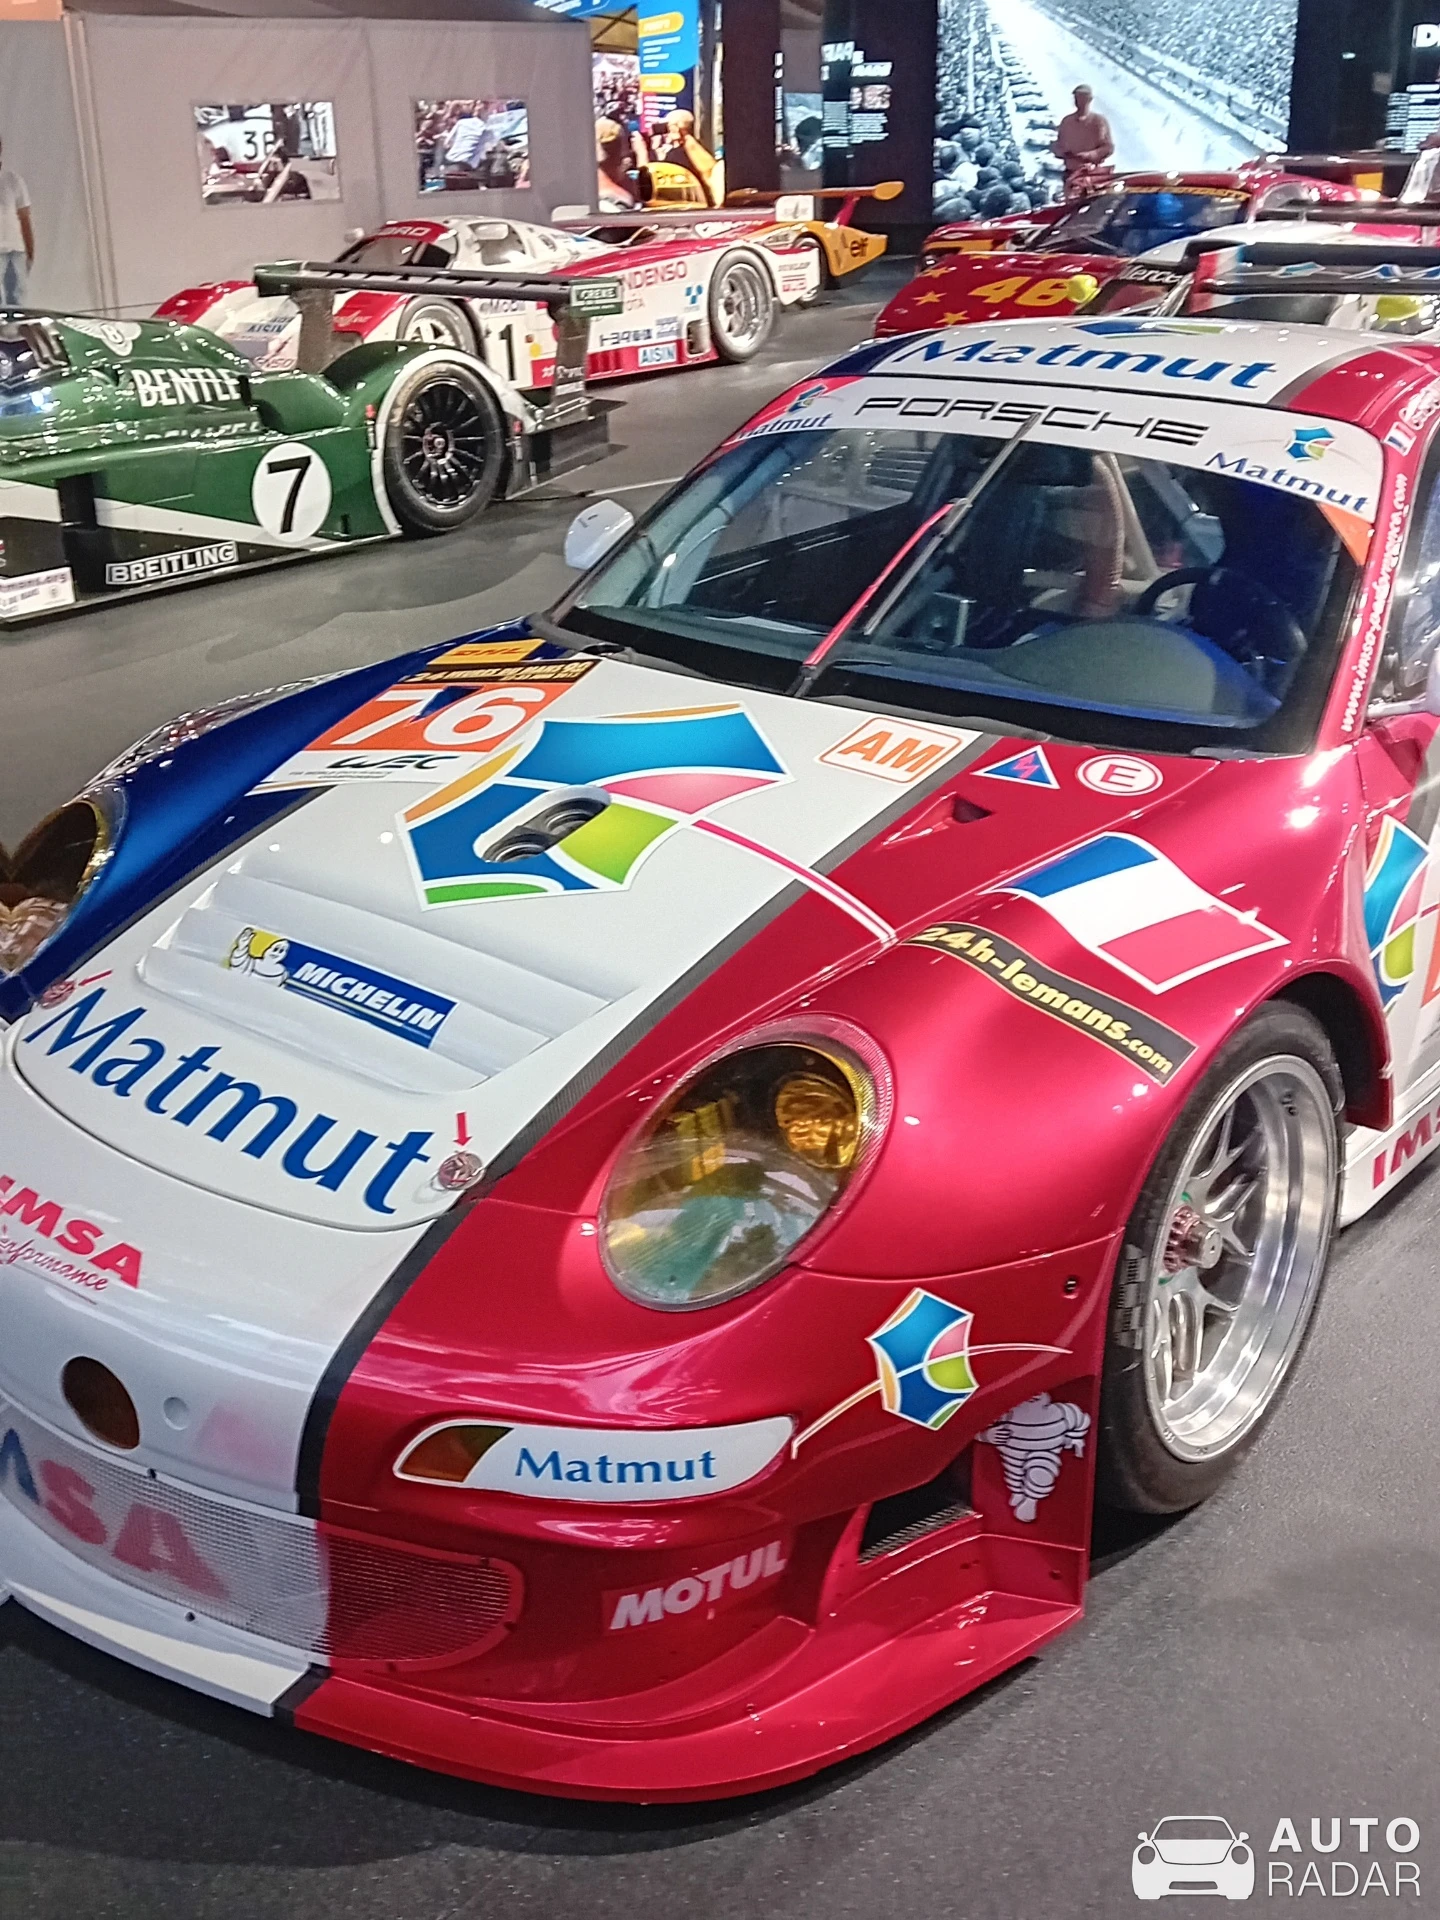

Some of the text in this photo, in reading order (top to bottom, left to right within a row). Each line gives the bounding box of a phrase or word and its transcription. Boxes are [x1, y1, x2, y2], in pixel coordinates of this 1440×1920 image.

[850, 237, 868, 257] elf
[621, 260, 688, 291] NDENSO
[968, 276, 1070, 306] 46
[499, 324, 516, 381] 1
[892, 338, 1277, 389] Matmut
[131, 368, 243, 408] BENTLE
[855, 397, 1210, 446] PORSCHE
[267, 454, 312, 534] 7
[1204, 451, 1370, 514] Matmut
[111, 544, 235, 583] BREITLING
[330, 687, 546, 746] 76
[837, 730, 945, 773] AM
[1100, 764, 1140, 788] E
[292, 962, 446, 1031] MICHELIN
[915, 927, 1173, 1074] 24h-lemans.com
[22, 987, 435, 1215] Matmut
[0, 1238, 109, 1291] erformance
[515, 1447, 717, 1484] Matmut
[609, 1540, 788, 1630] MOTUL
